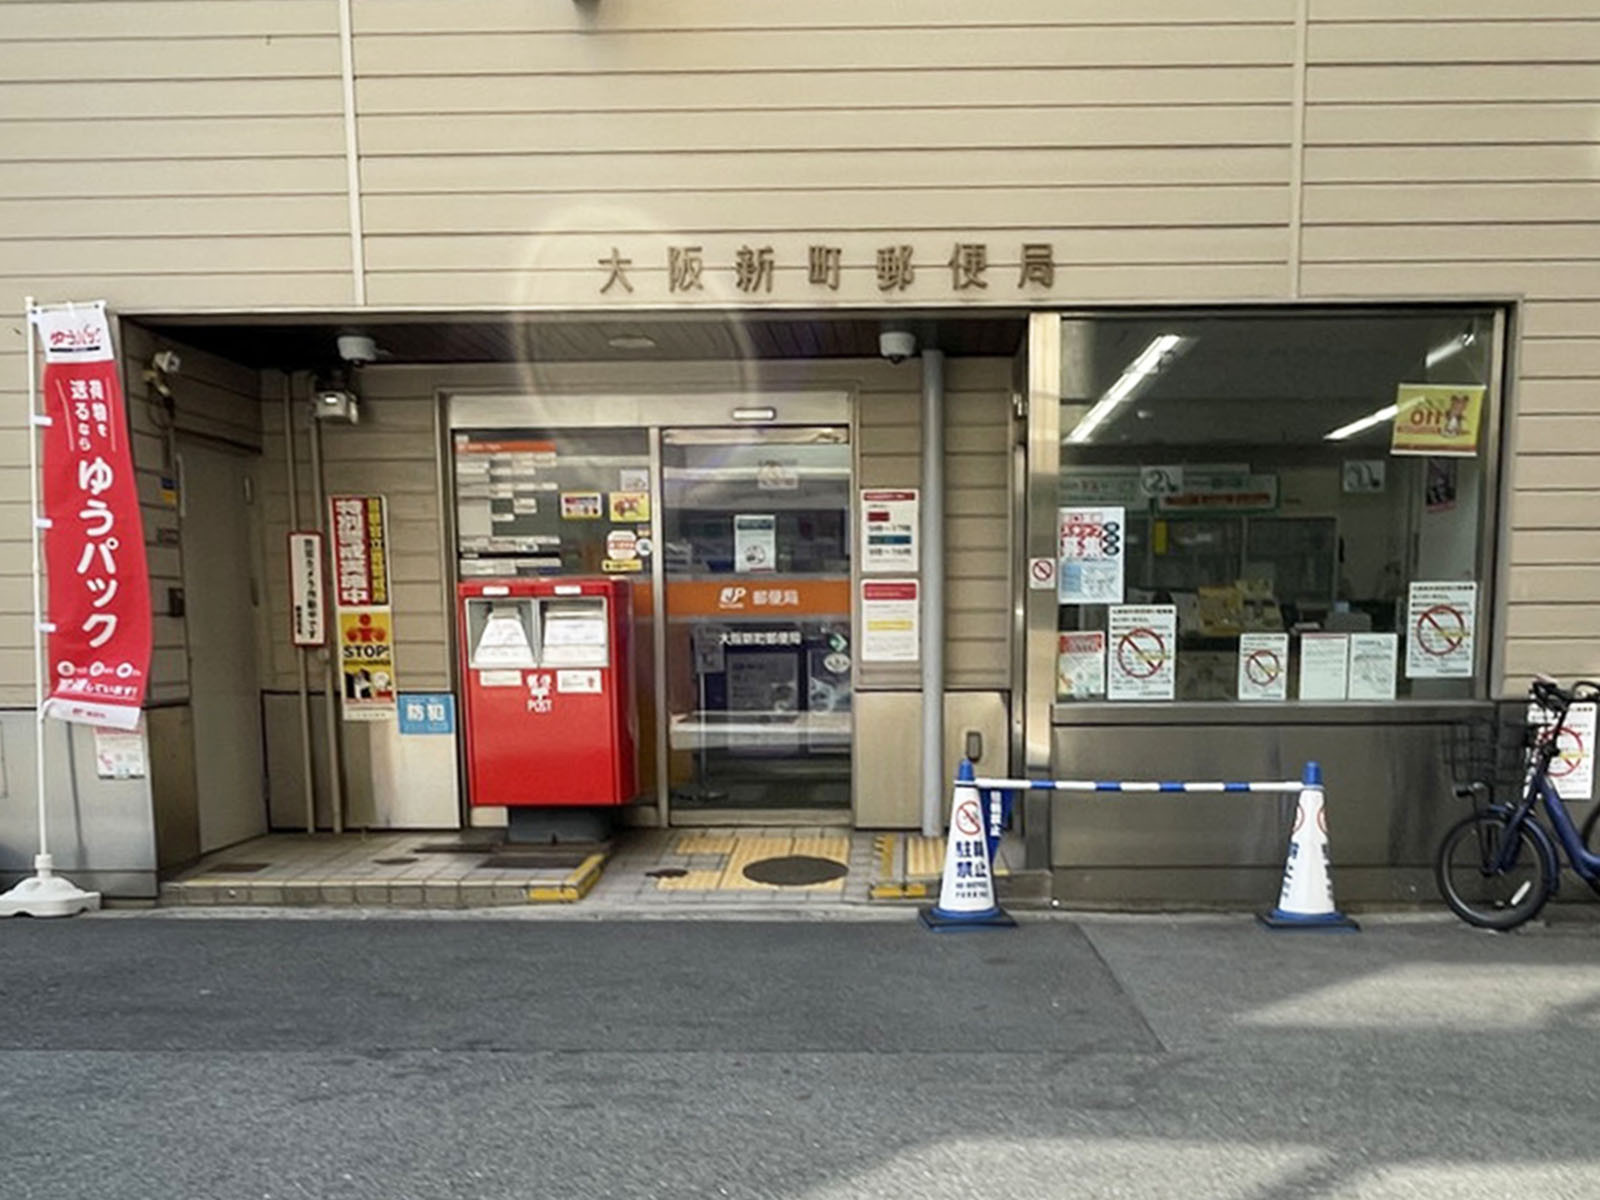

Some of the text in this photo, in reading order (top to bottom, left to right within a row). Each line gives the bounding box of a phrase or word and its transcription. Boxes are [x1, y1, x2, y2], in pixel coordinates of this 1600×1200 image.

[597, 243, 1057, 294] 大阪新町郵便局
[77, 456, 120, 648] ゆうパック
[752, 589, 800, 606] 郵便局
[719, 631, 802, 646] 大阪新町郵便局
[527, 700, 552, 713] POST
[956, 861, 988, 879] 禁止
